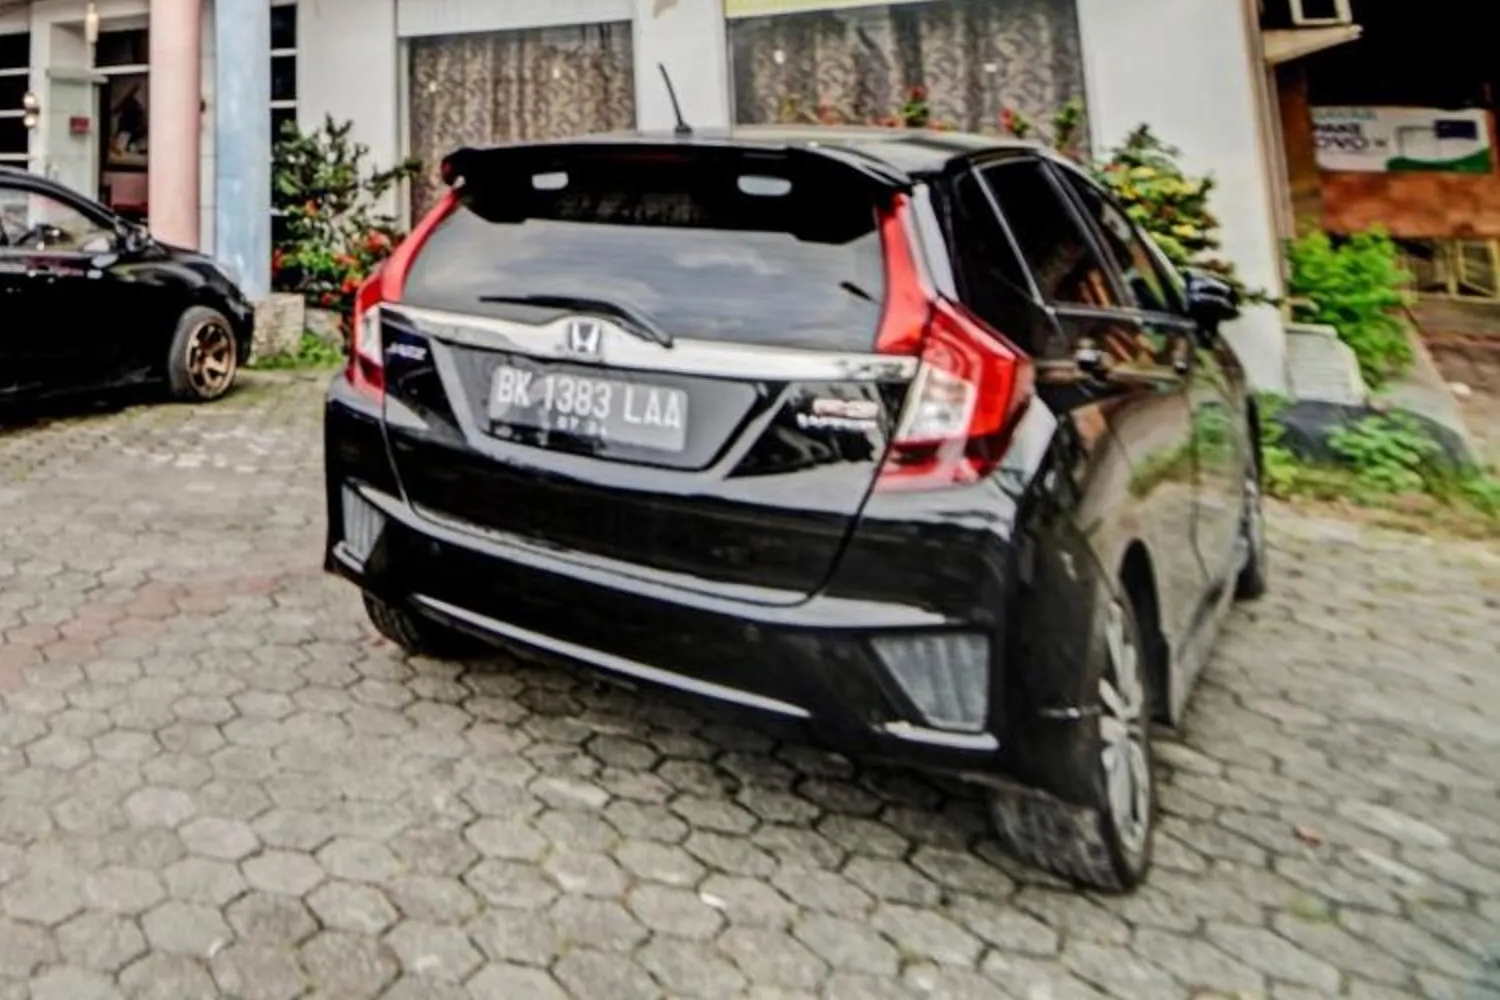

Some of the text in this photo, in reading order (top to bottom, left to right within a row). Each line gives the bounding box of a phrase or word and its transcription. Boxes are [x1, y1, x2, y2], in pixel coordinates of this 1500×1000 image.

[498, 366, 533, 409] BK
[544, 375, 612, 420] 1383
[623, 385, 681, 429] LAA
